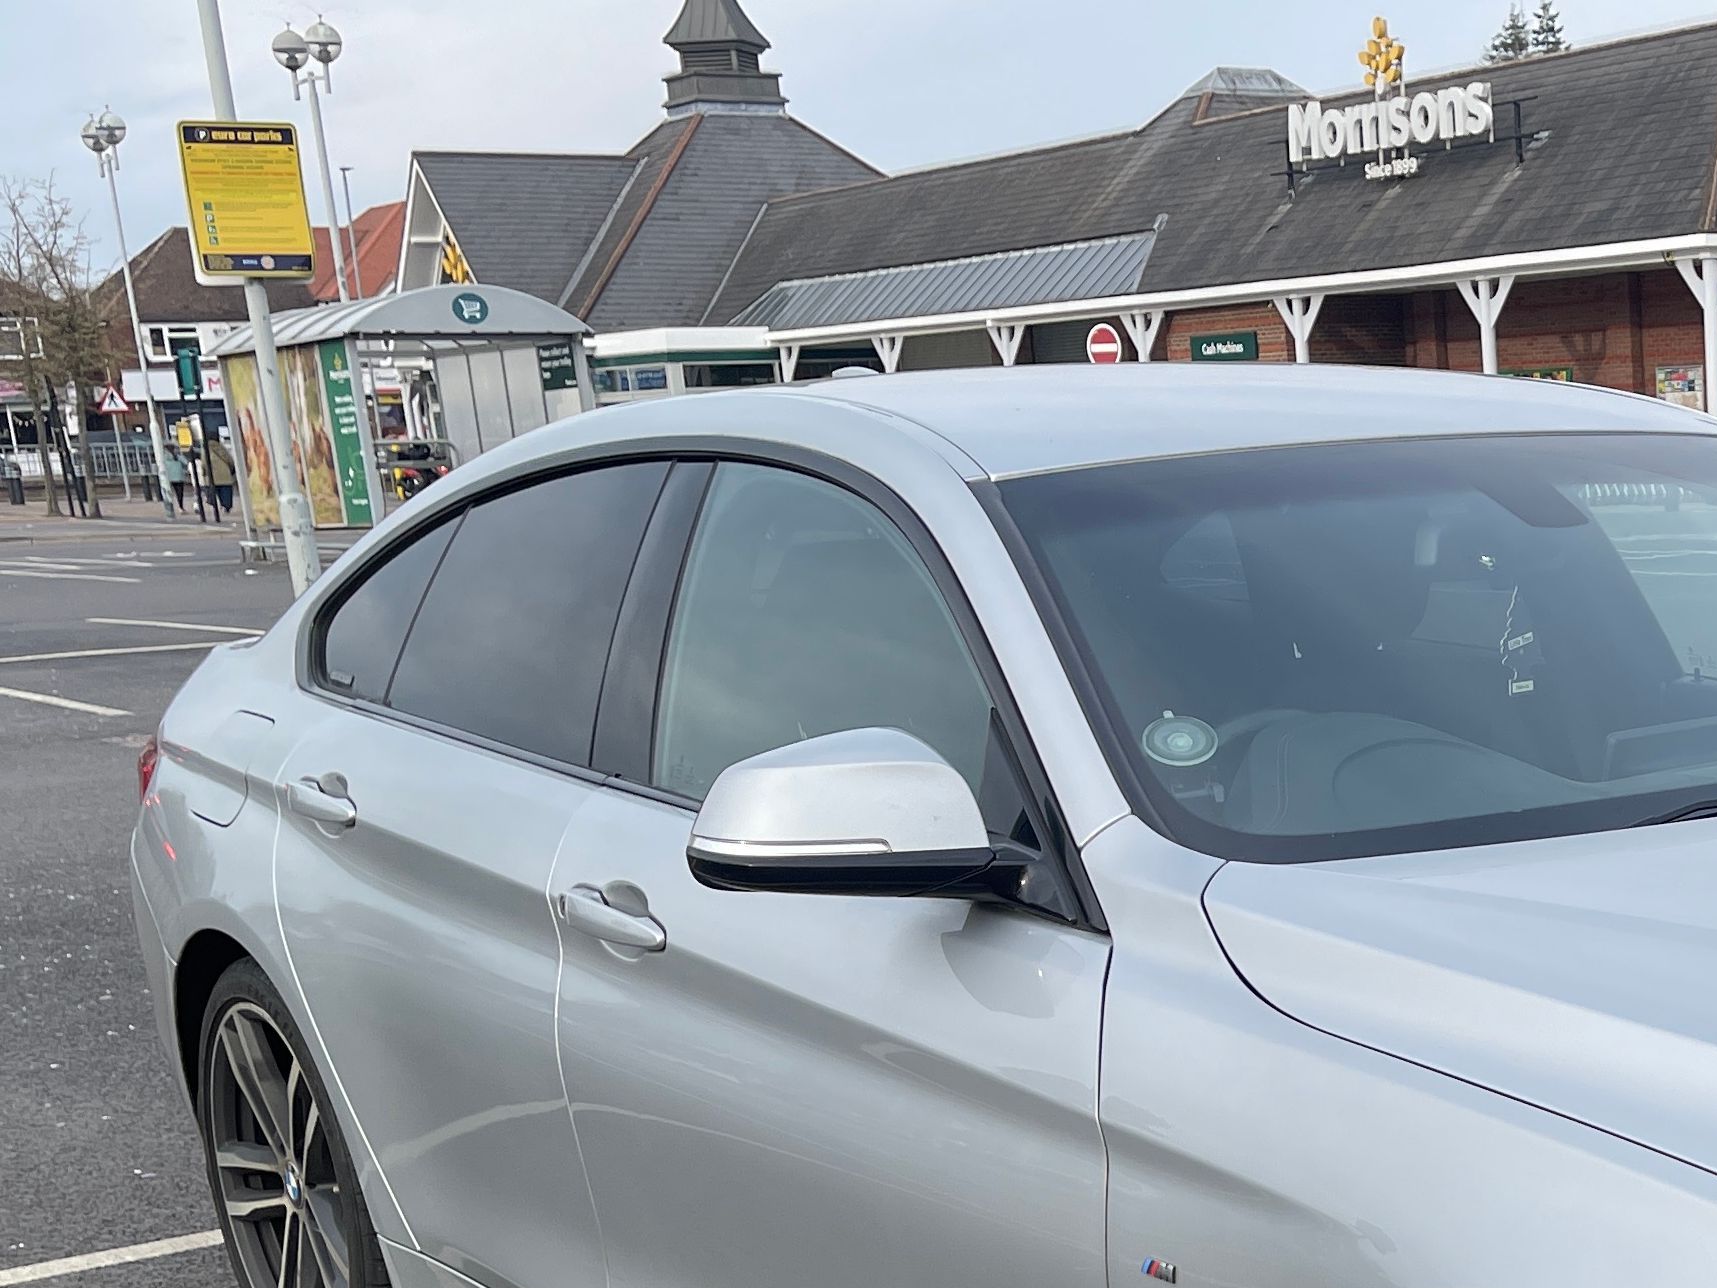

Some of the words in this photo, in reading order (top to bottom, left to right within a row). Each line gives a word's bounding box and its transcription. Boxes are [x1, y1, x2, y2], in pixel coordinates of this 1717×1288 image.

[1288, 82, 1491, 162] Morrisons
[1364, 162, 1392, 180] Since
[1392, 157, 1418, 176] 1899
